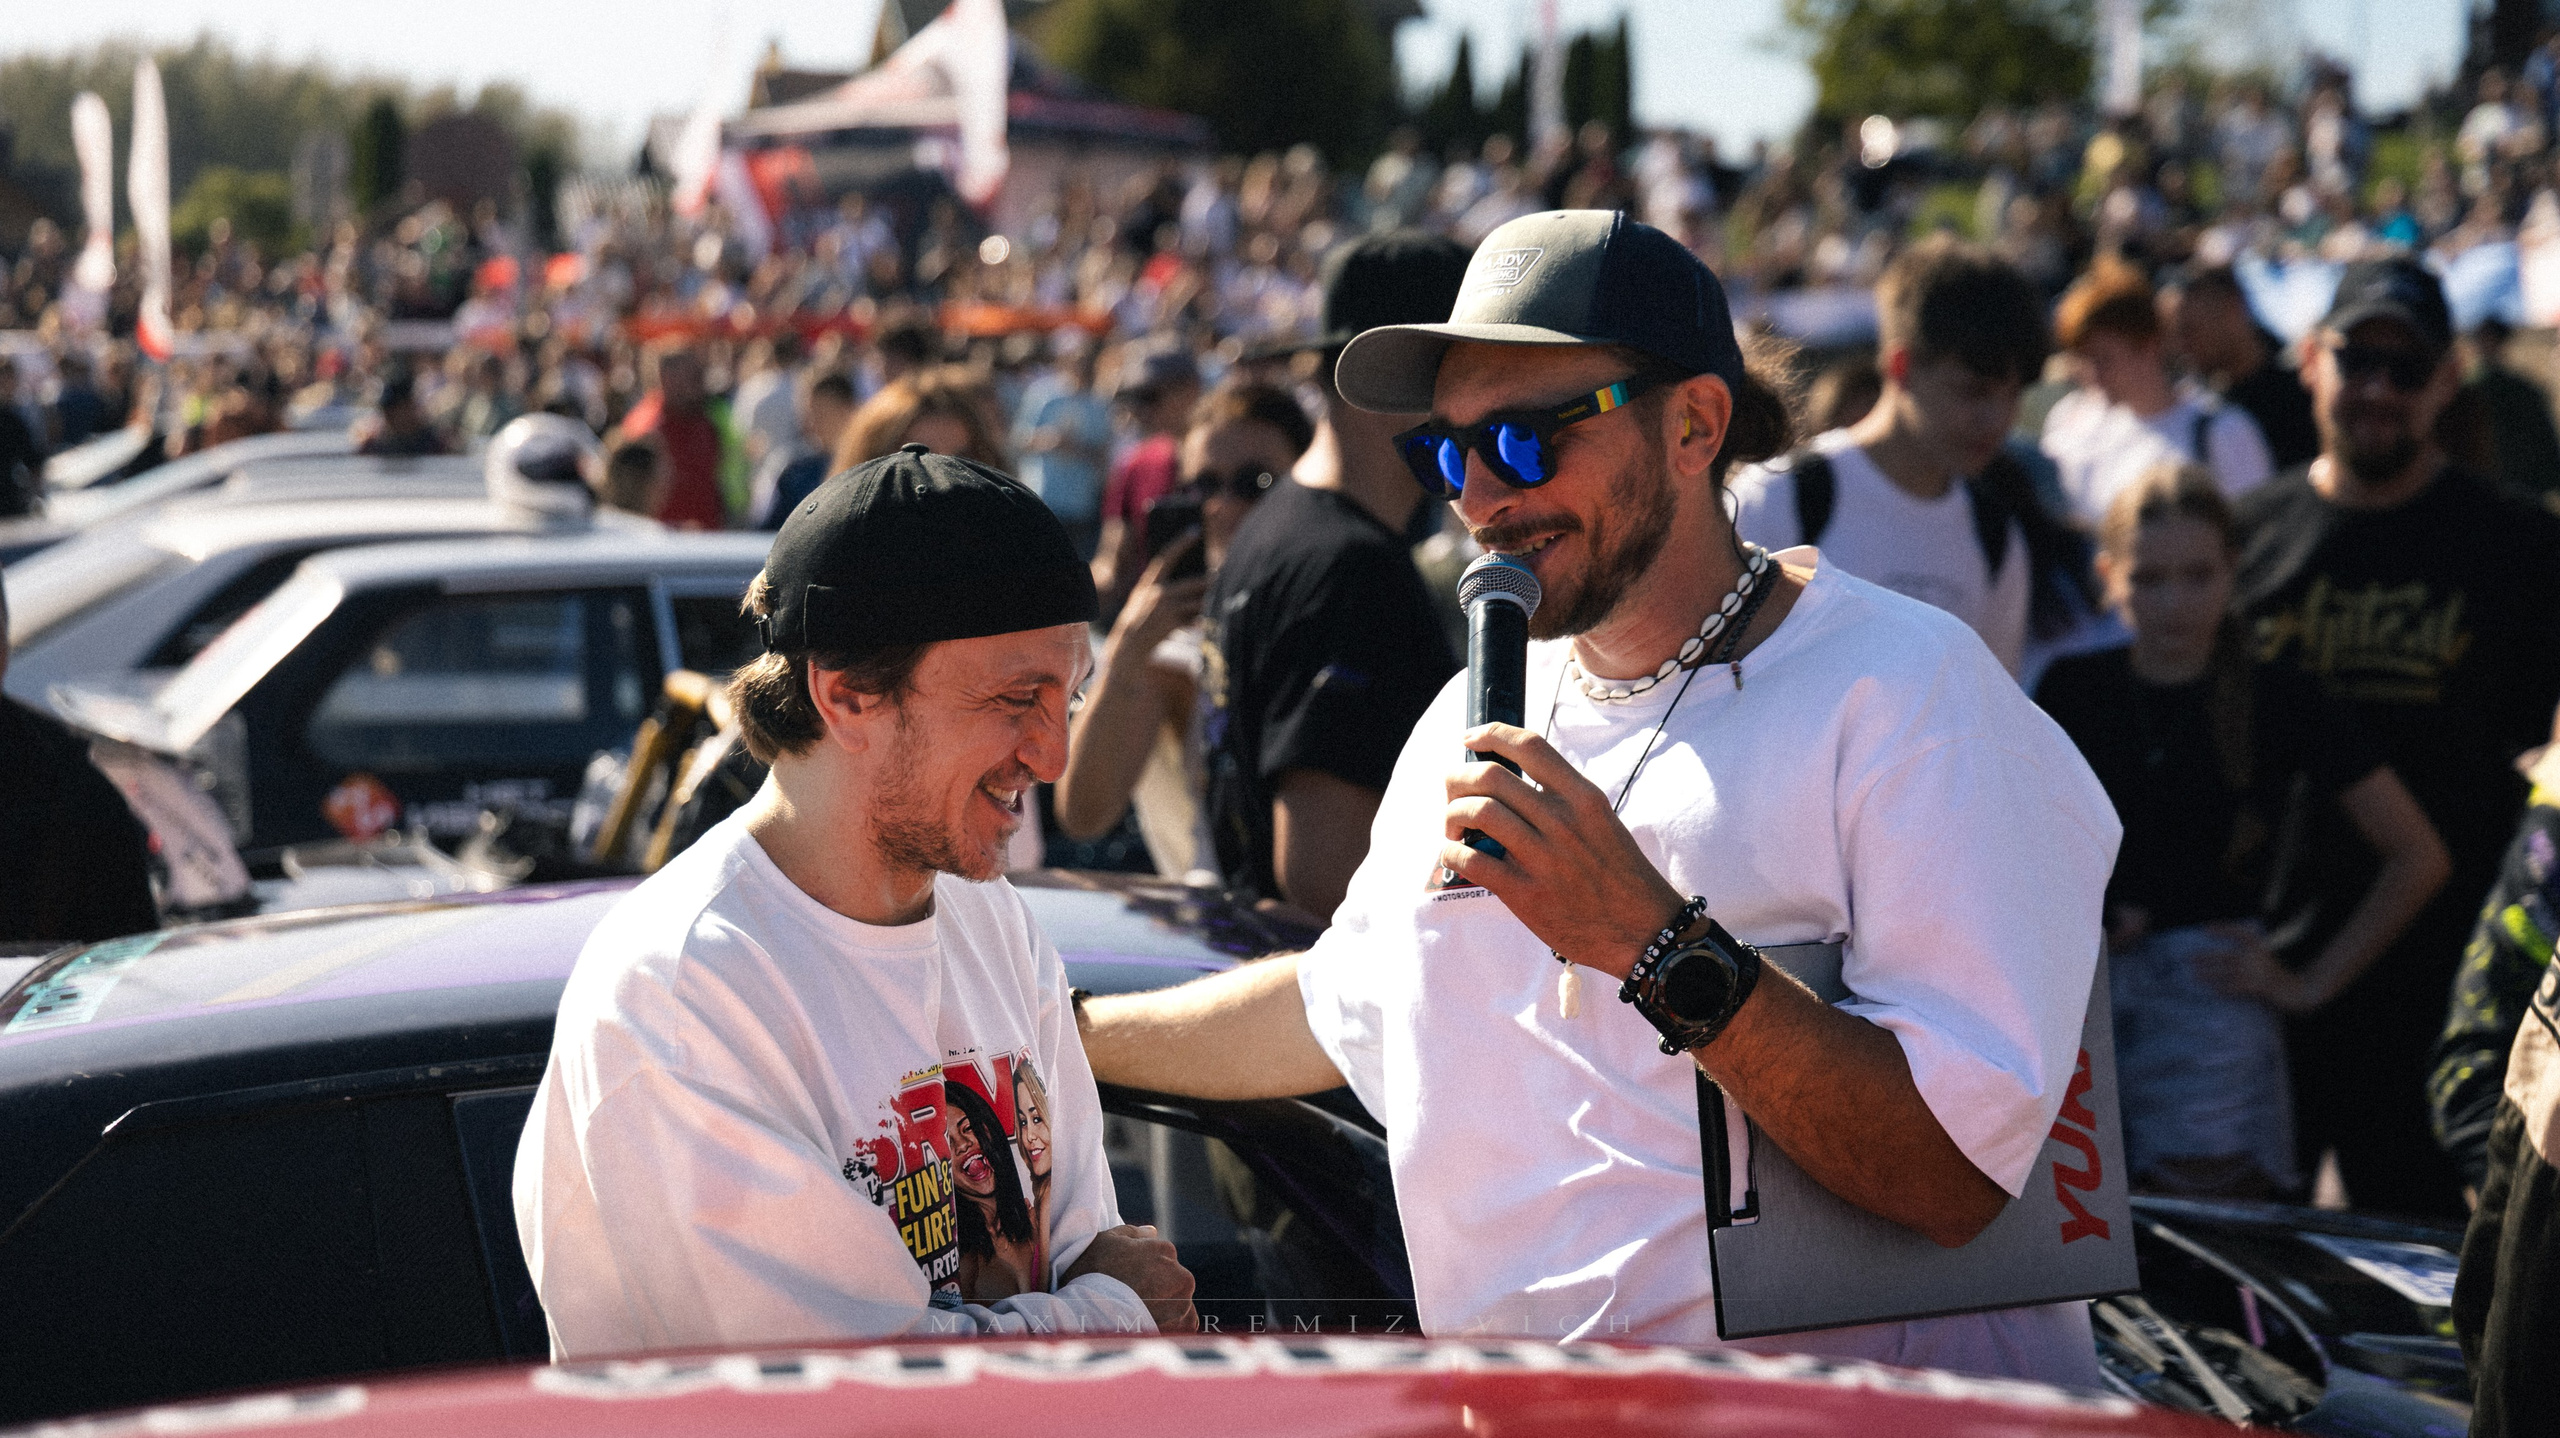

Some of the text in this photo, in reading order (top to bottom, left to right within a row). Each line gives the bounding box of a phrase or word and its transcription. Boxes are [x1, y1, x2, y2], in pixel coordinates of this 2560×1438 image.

[1437, 890, 1485, 902] MOTORSPORT
[896, 1166, 940, 1220] FUN
[921, 1246, 960, 1282] ARTE
